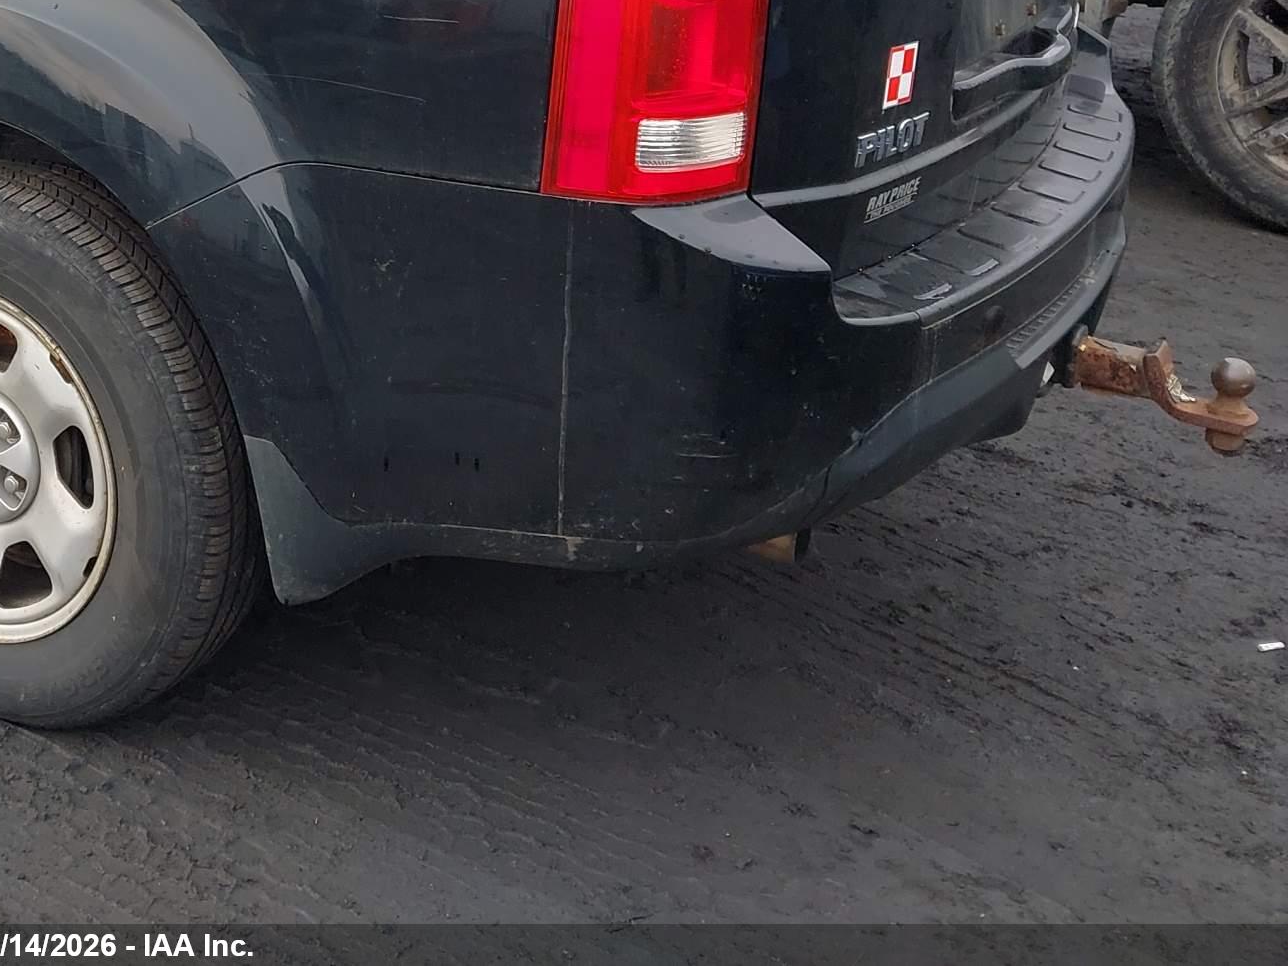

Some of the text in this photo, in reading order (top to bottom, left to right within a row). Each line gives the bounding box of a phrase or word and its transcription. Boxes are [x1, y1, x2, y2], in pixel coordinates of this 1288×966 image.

[854, 111, 930, 168] PILOT
[866, 190, 891, 212] RAY
[889, 176, 922, 202] PRICE
